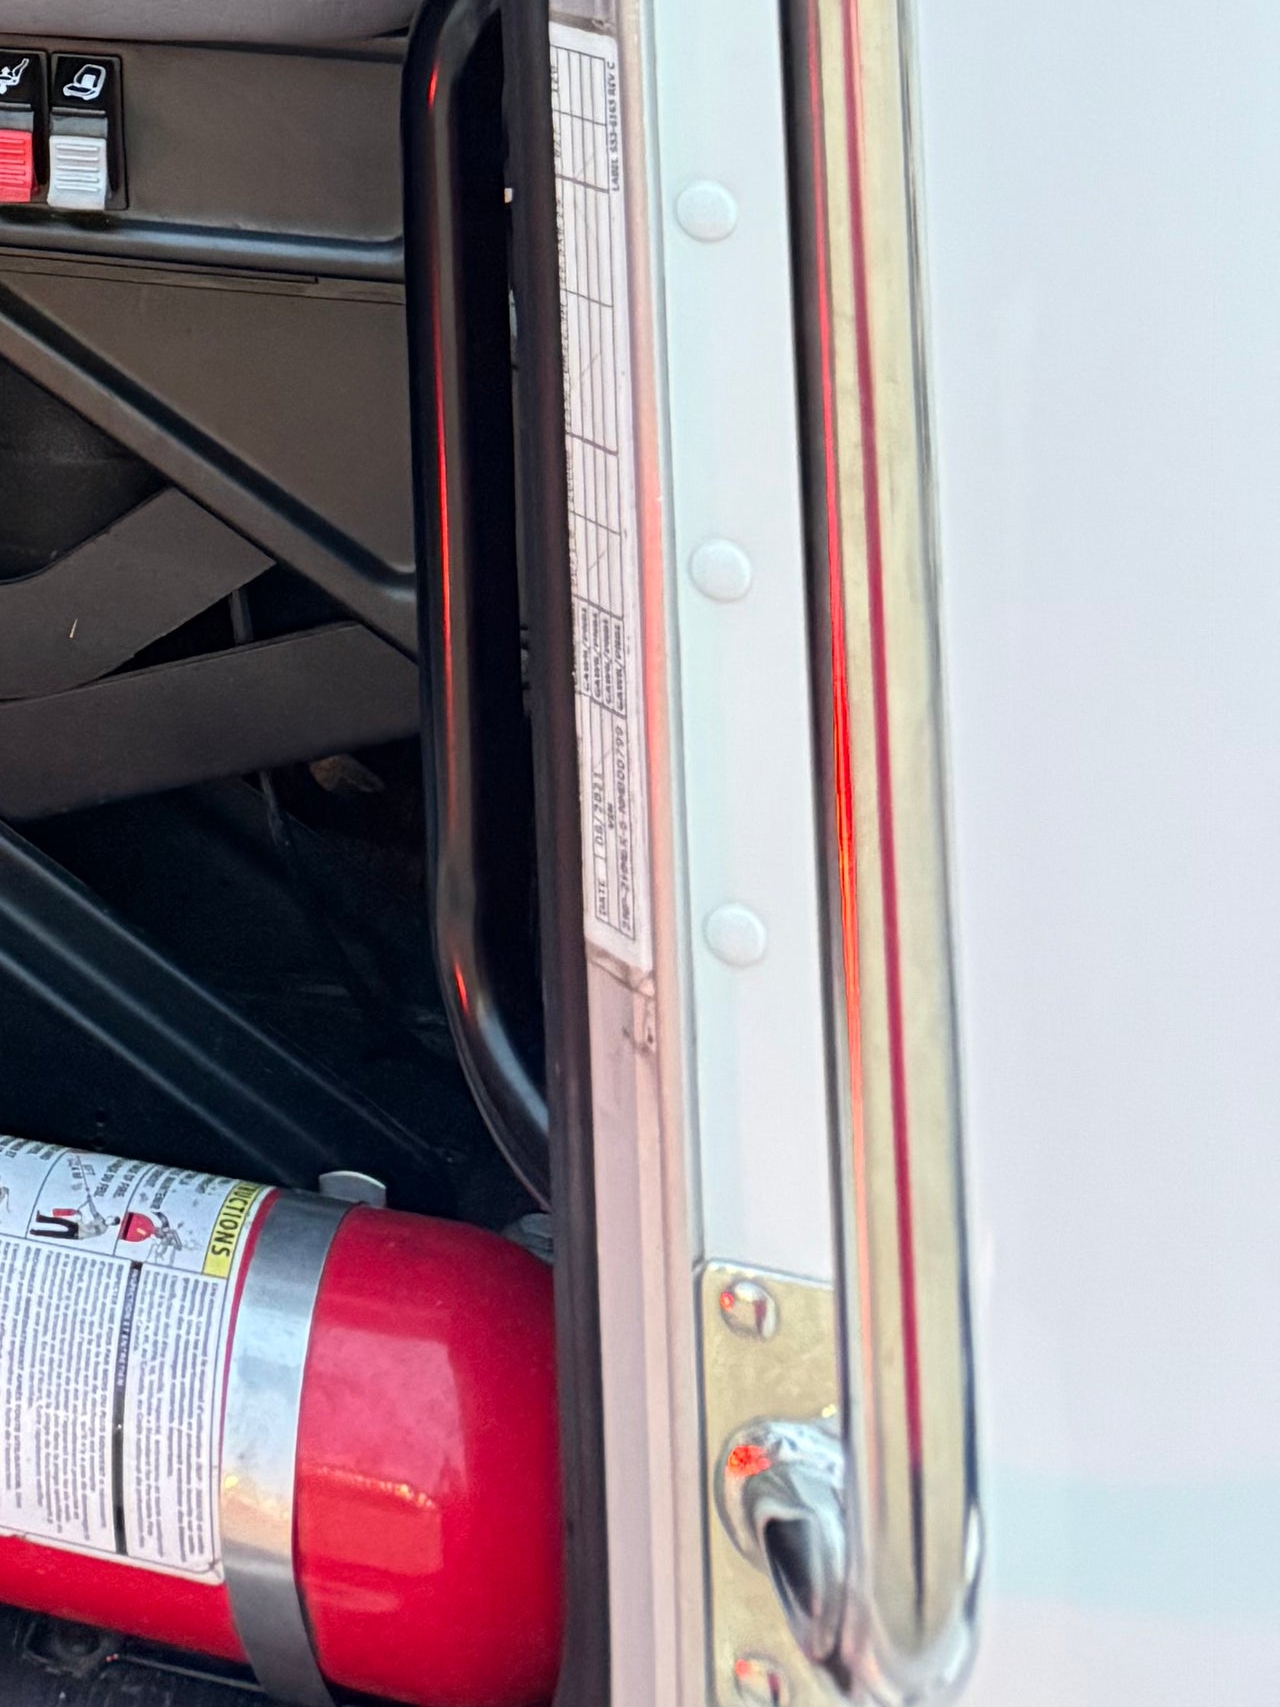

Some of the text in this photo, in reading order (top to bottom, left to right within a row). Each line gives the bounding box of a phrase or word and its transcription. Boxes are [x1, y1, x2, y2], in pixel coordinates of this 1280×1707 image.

[606, 74, 616, 96] REV
[610, 157, 620, 191] LABEL
[596, 878, 607, 916] DATE
[123, 1267, 138, 1319] INSPECTION
[121, 1321, 129, 1331] ET
